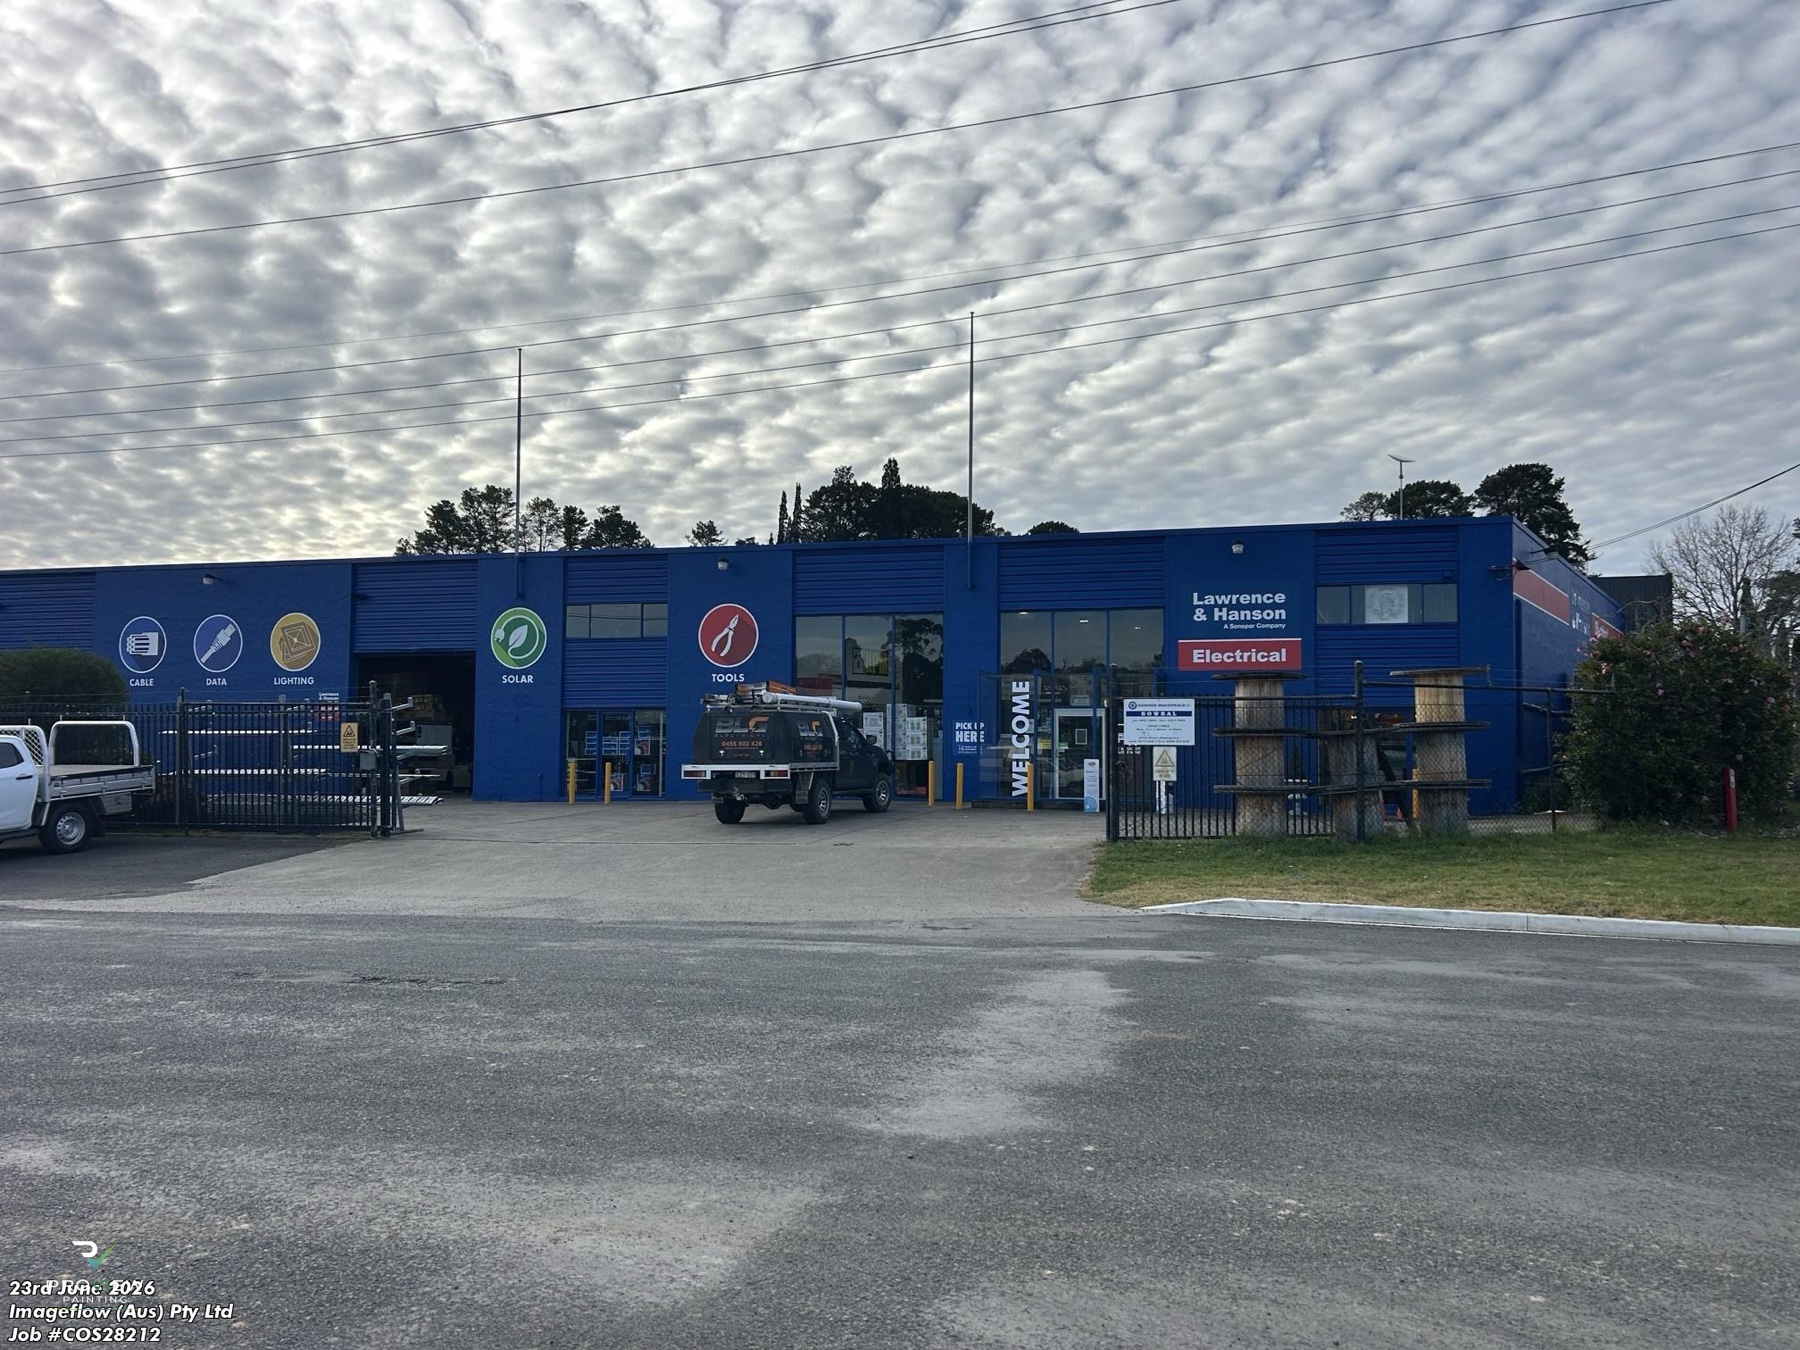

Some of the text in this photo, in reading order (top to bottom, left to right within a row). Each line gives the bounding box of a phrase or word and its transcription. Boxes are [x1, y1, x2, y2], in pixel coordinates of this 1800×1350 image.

[1193, 593, 1287, 606] Lawrence
[1193, 607, 1287, 622] & Hanson
[1256, 622, 1287, 630] Company
[1192, 648, 1287, 663] Electrical
[129, 678, 154, 687] CABLE
[206, 677, 228, 686] DATA
[273, 676, 315, 686] LIGHTING
[502, 674, 534, 684] SOLAR
[711, 673, 745, 683] TOOLS
[955, 722, 973, 730] PICK
[955, 730, 985, 743] HERE
[1011, 680, 1030, 797] WELCOME
